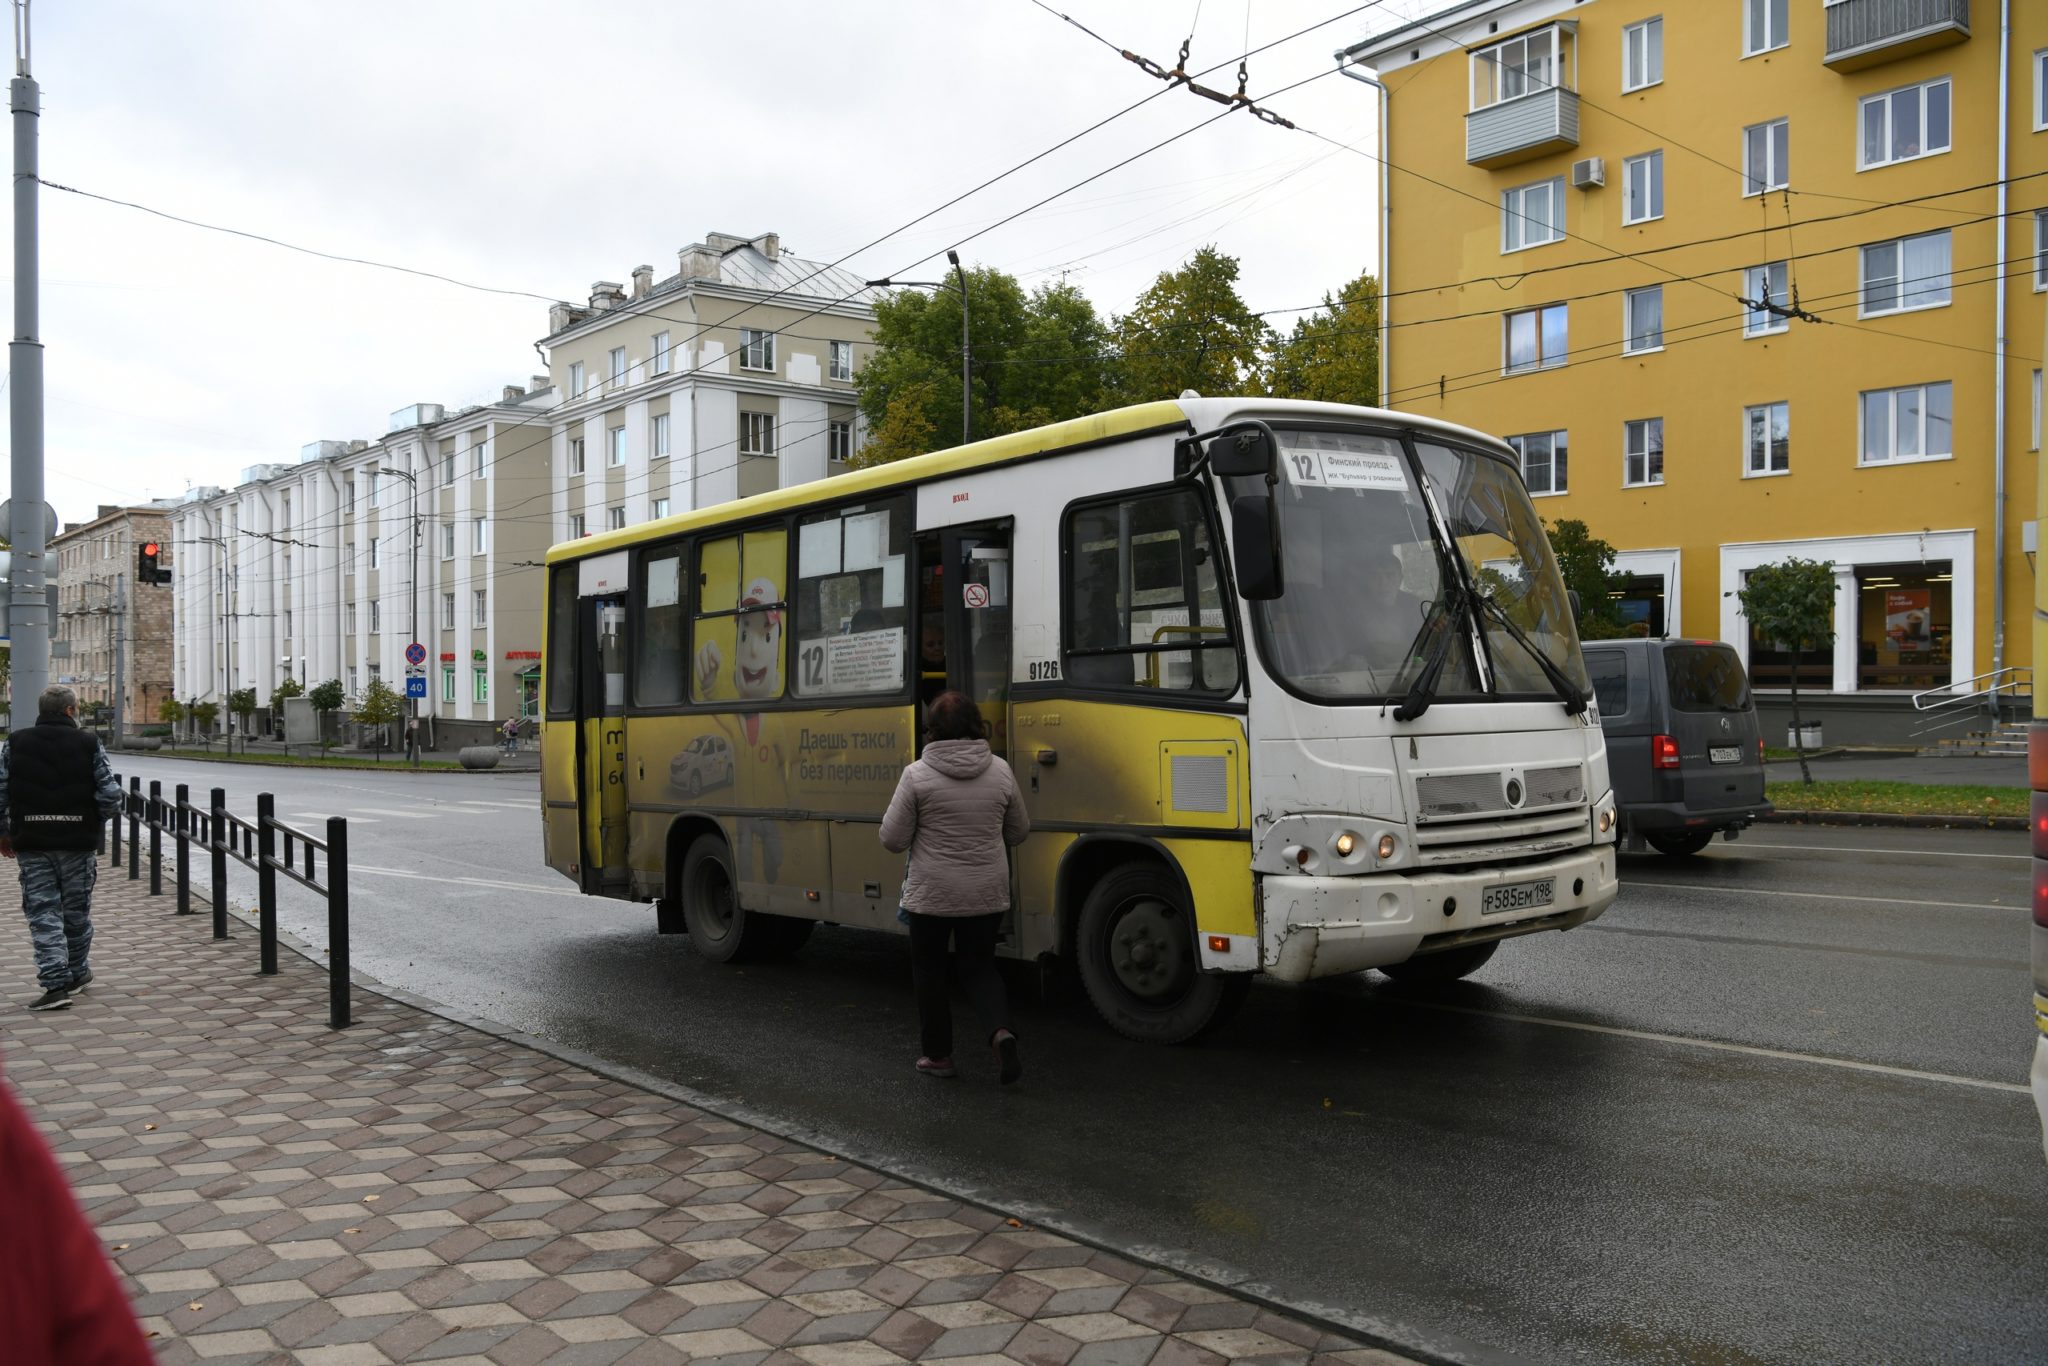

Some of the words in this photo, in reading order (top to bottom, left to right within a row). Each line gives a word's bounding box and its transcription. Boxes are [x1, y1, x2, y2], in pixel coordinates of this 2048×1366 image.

[1291, 455, 1317, 480] 12
[1328, 456, 1361, 467] Финский
[1362, 461, 1389, 471] проезд
[801, 646, 824, 687] 12
[1029, 661, 1058, 681] 9126
[410, 683, 423, 692] 40
[798, 728, 848, 754] Даешь
[851, 731, 896, 749] такси
[800, 759, 823, 780] без
